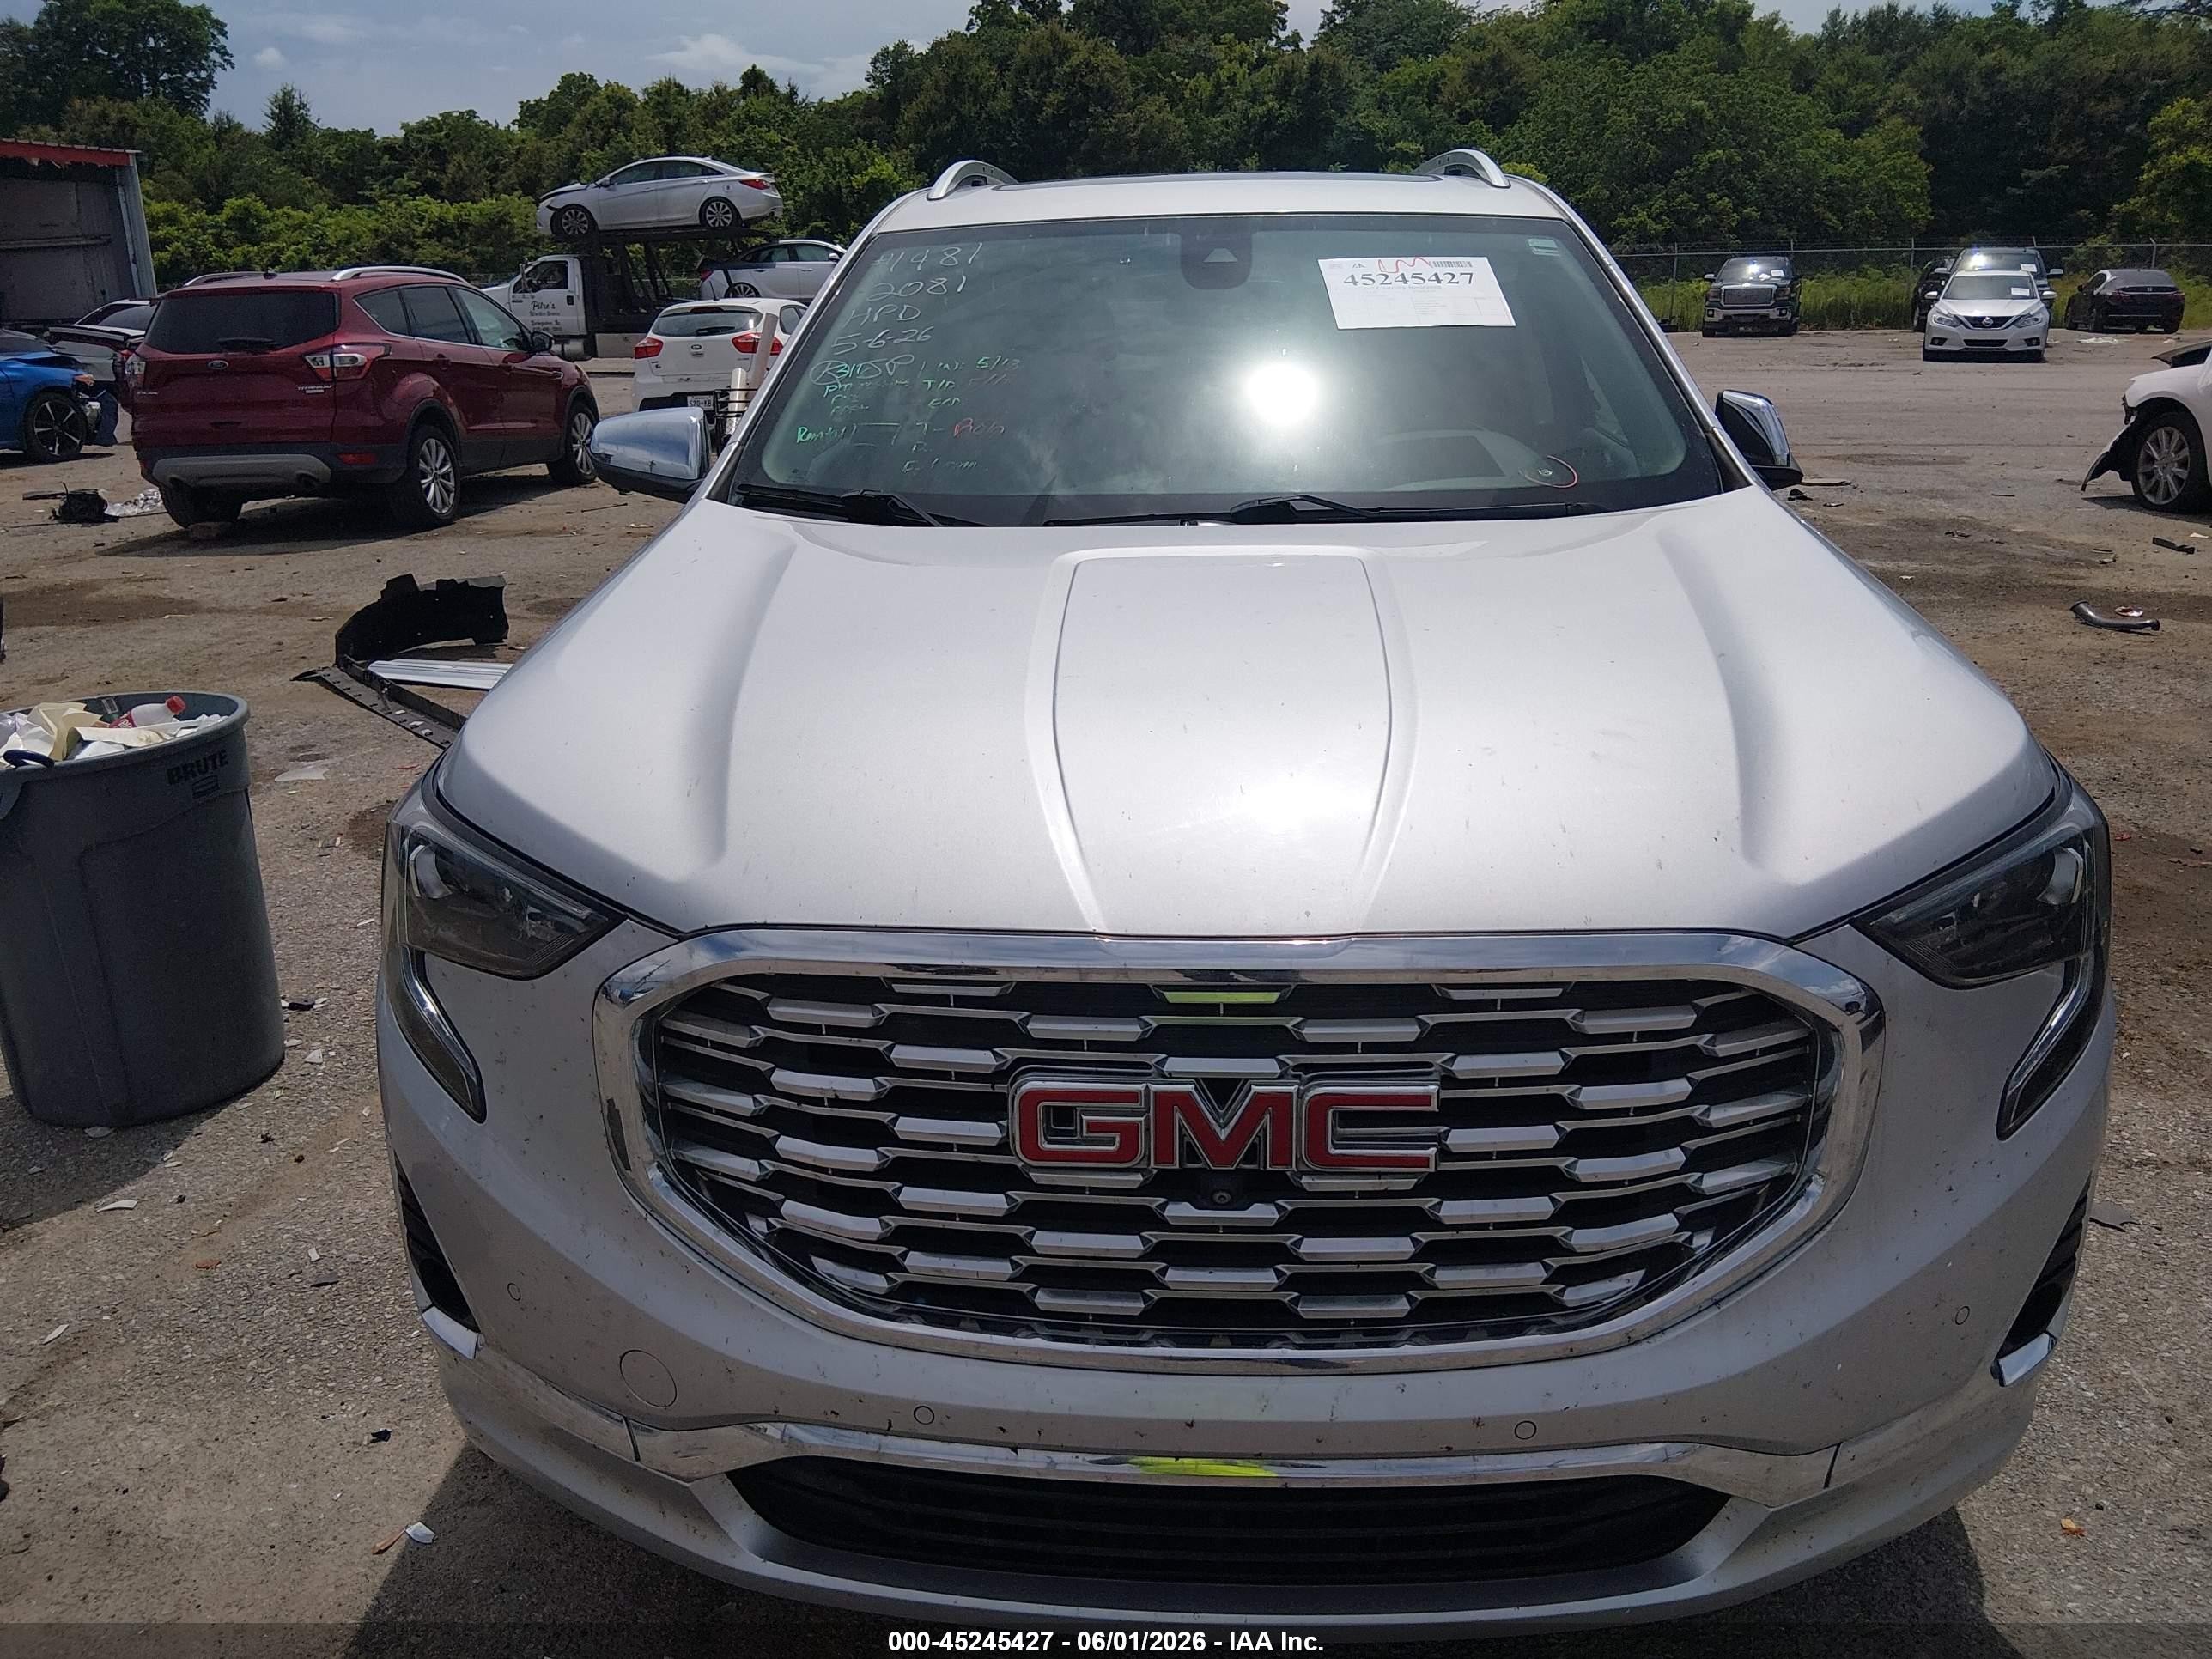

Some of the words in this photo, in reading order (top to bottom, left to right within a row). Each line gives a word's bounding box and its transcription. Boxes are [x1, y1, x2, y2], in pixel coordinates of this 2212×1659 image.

[867, 275, 967, 301] 2081
[1343, 272, 1474, 286] 45245427
[842, 304, 921, 329] HPD
[831, 325, 935, 356] 5-6-26
[167, 749, 228, 785] BRUTE
[1012, 1080, 1439, 1172] GMC
